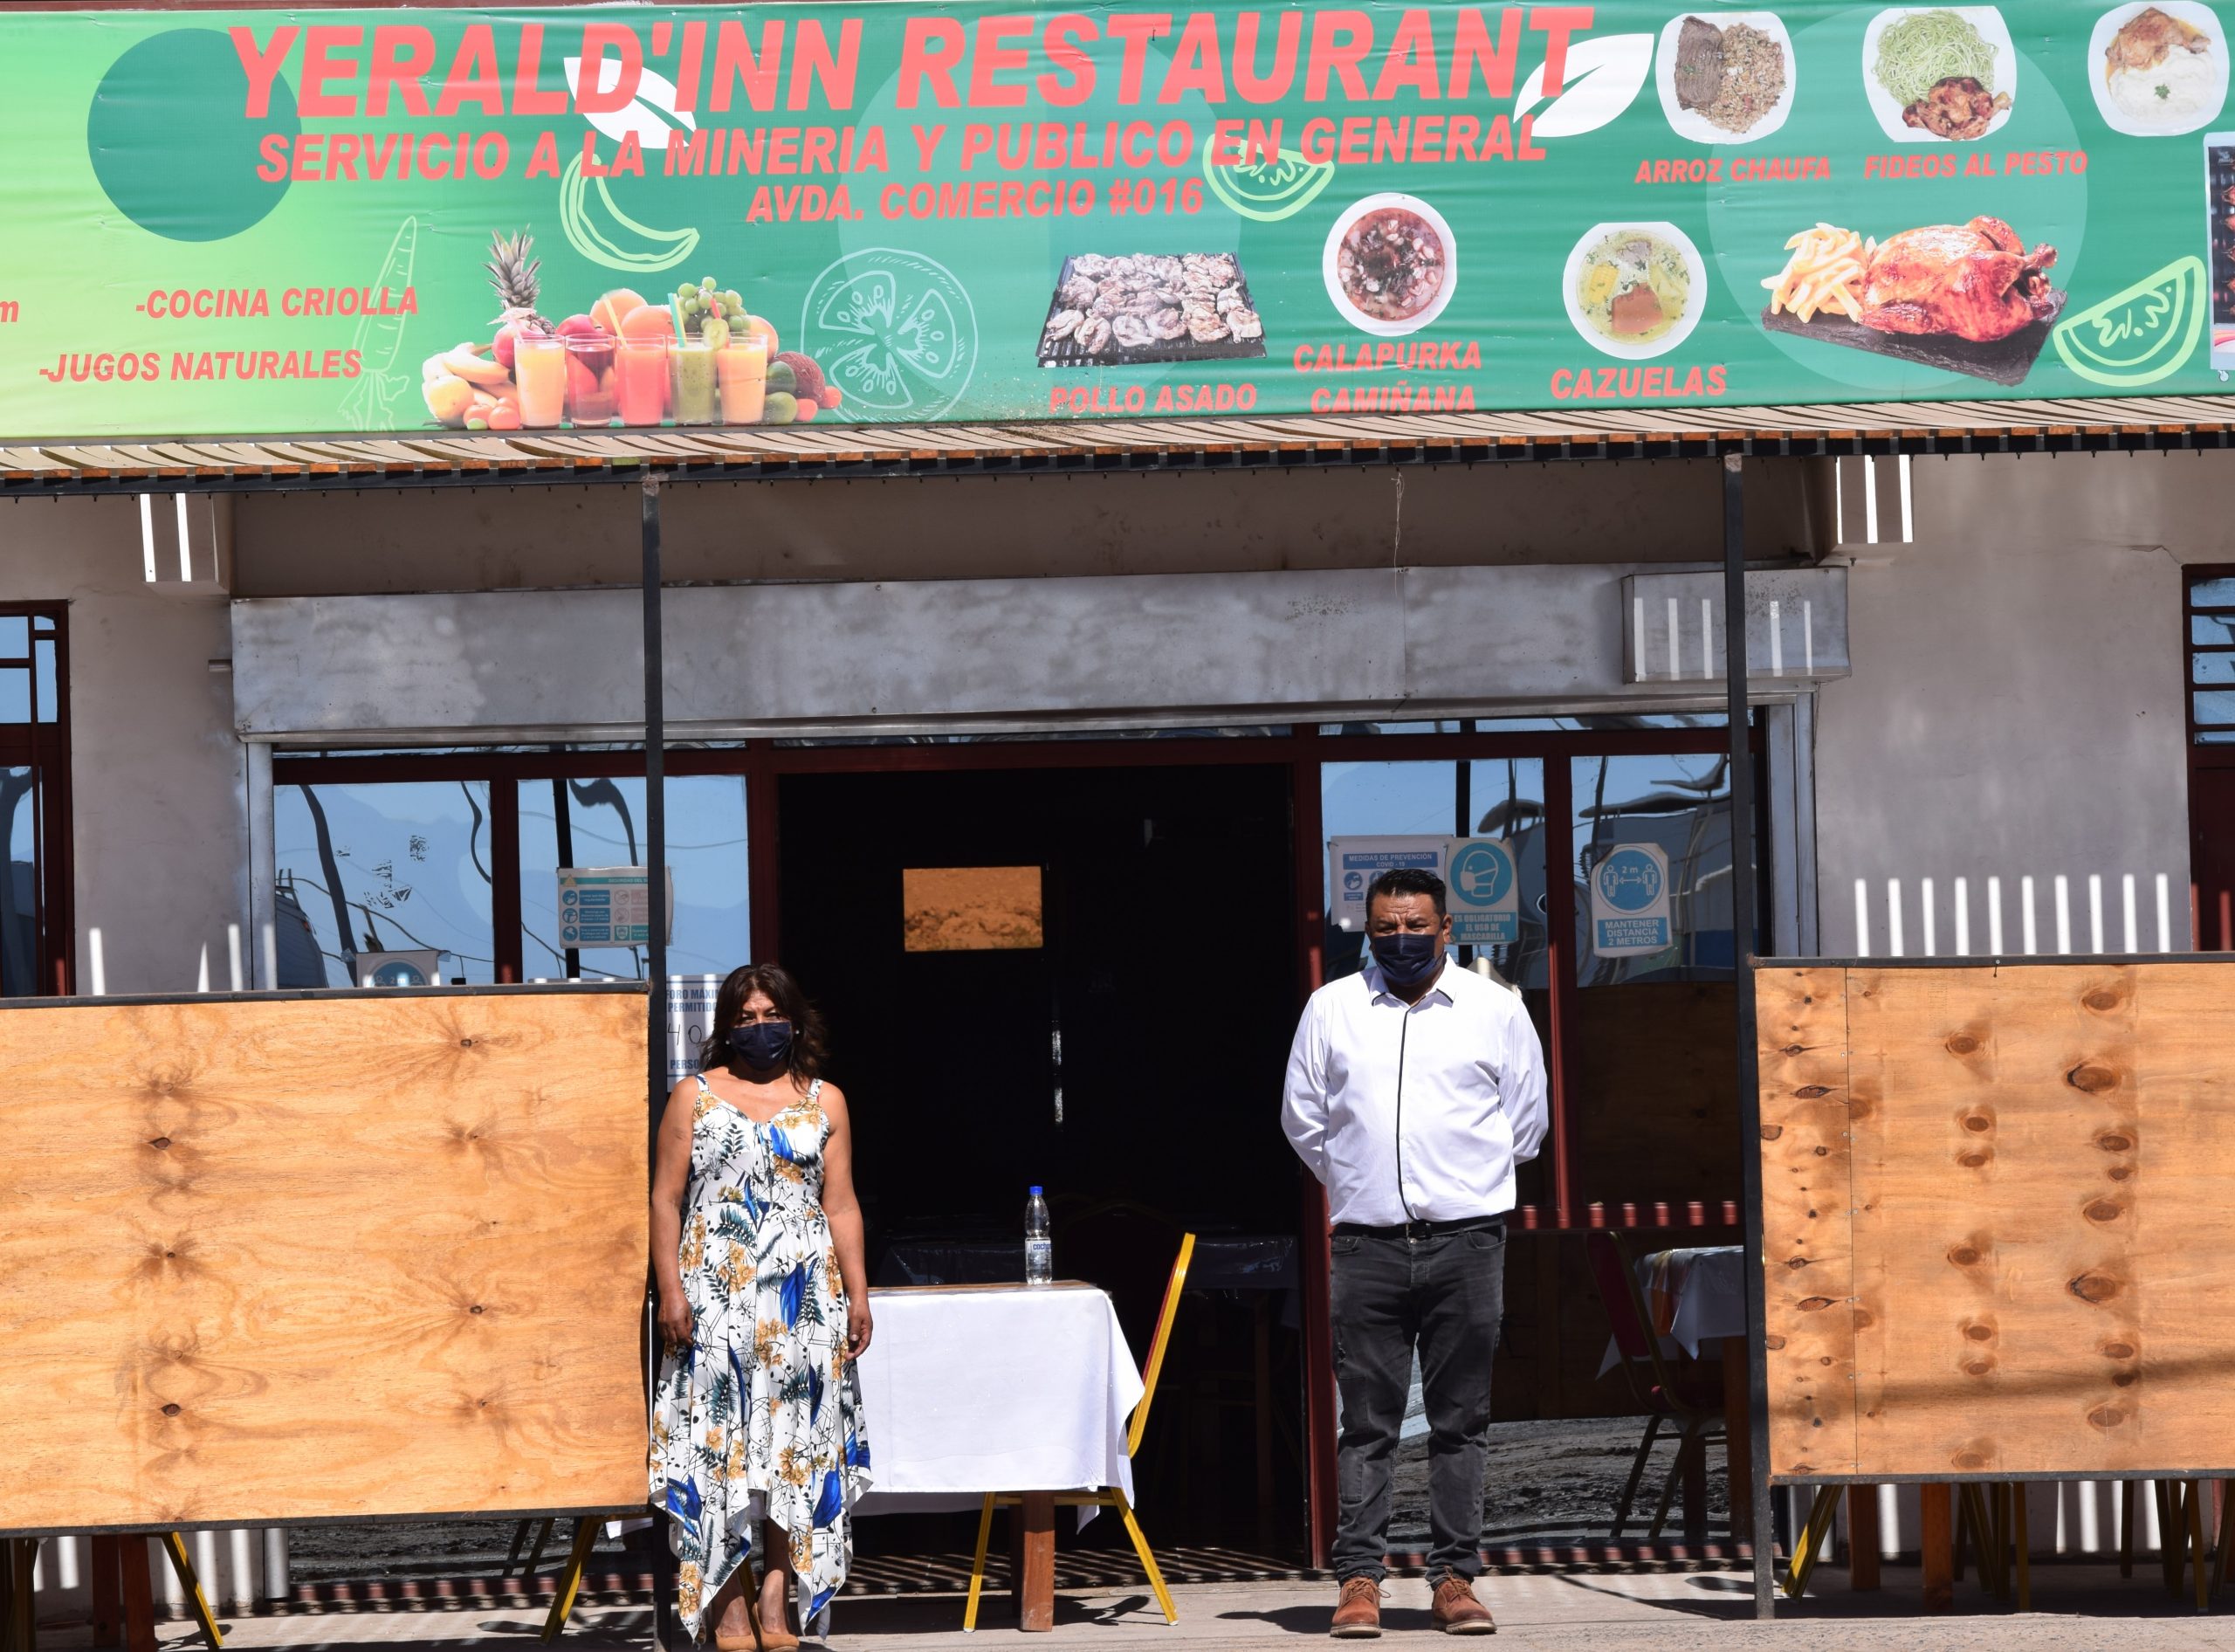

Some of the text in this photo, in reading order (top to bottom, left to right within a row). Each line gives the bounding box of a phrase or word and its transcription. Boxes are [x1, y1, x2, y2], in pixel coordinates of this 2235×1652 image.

[229, 7, 1594, 118] YERALD'INN RESTAURANT
[257, 114, 1546, 182] SERVICIO A LA MINERIA Y PUBLICO EN GENERAL
[1634, 157, 1831, 183] ARROZ CHAUFA
[1864, 151, 2088, 179] FIDEOS AL PESTO
[746, 177, 1204, 222] AVDA. COMERCIO #016
[136, 287, 418, 319] -COCINA CRIOLLA
[39, 349, 362, 382] -JUGOS NATURALES
[1293, 341, 1482, 373] CALAPURKA
[1311, 381, 1475, 414] CAMIÑANA
[1551, 366, 1727, 399] CAZUELAS
[1049, 383, 1257, 413] POLLO ASADO
[1464, 913, 1510, 922] OBLIGATORIO
[1605, 919, 1660, 929] MANTENER
[1461, 932, 1506, 940] MASCARILLA
[1606, 928, 1659, 938] DISTANCIA
[1616, 936, 1657, 945] METROS
[670, 1059, 699, 1070] PERSO
